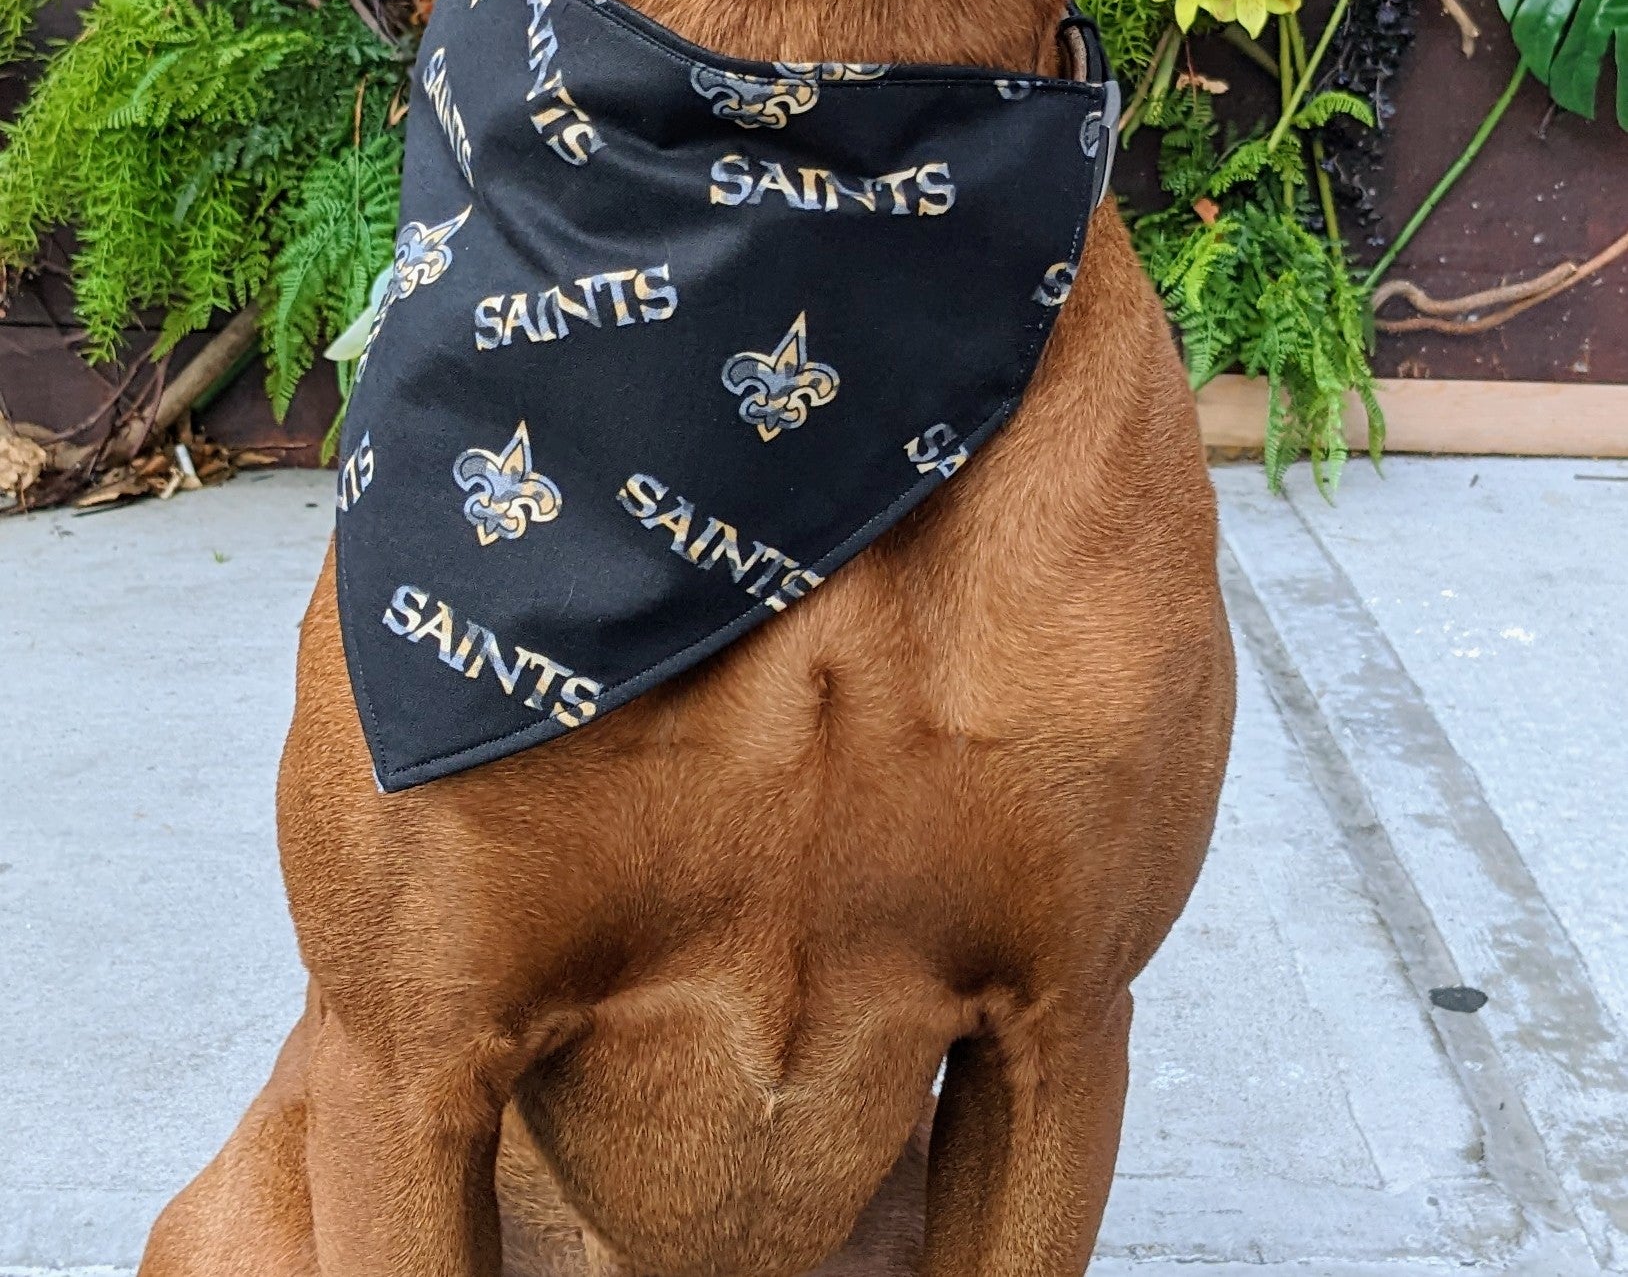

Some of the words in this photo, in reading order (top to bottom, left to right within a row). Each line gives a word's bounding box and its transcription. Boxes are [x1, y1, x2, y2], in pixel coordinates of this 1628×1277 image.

[710, 153, 957, 216] SAINTS
[474, 263, 679, 351] SAINTS
[382, 585, 603, 727] SAINTS
